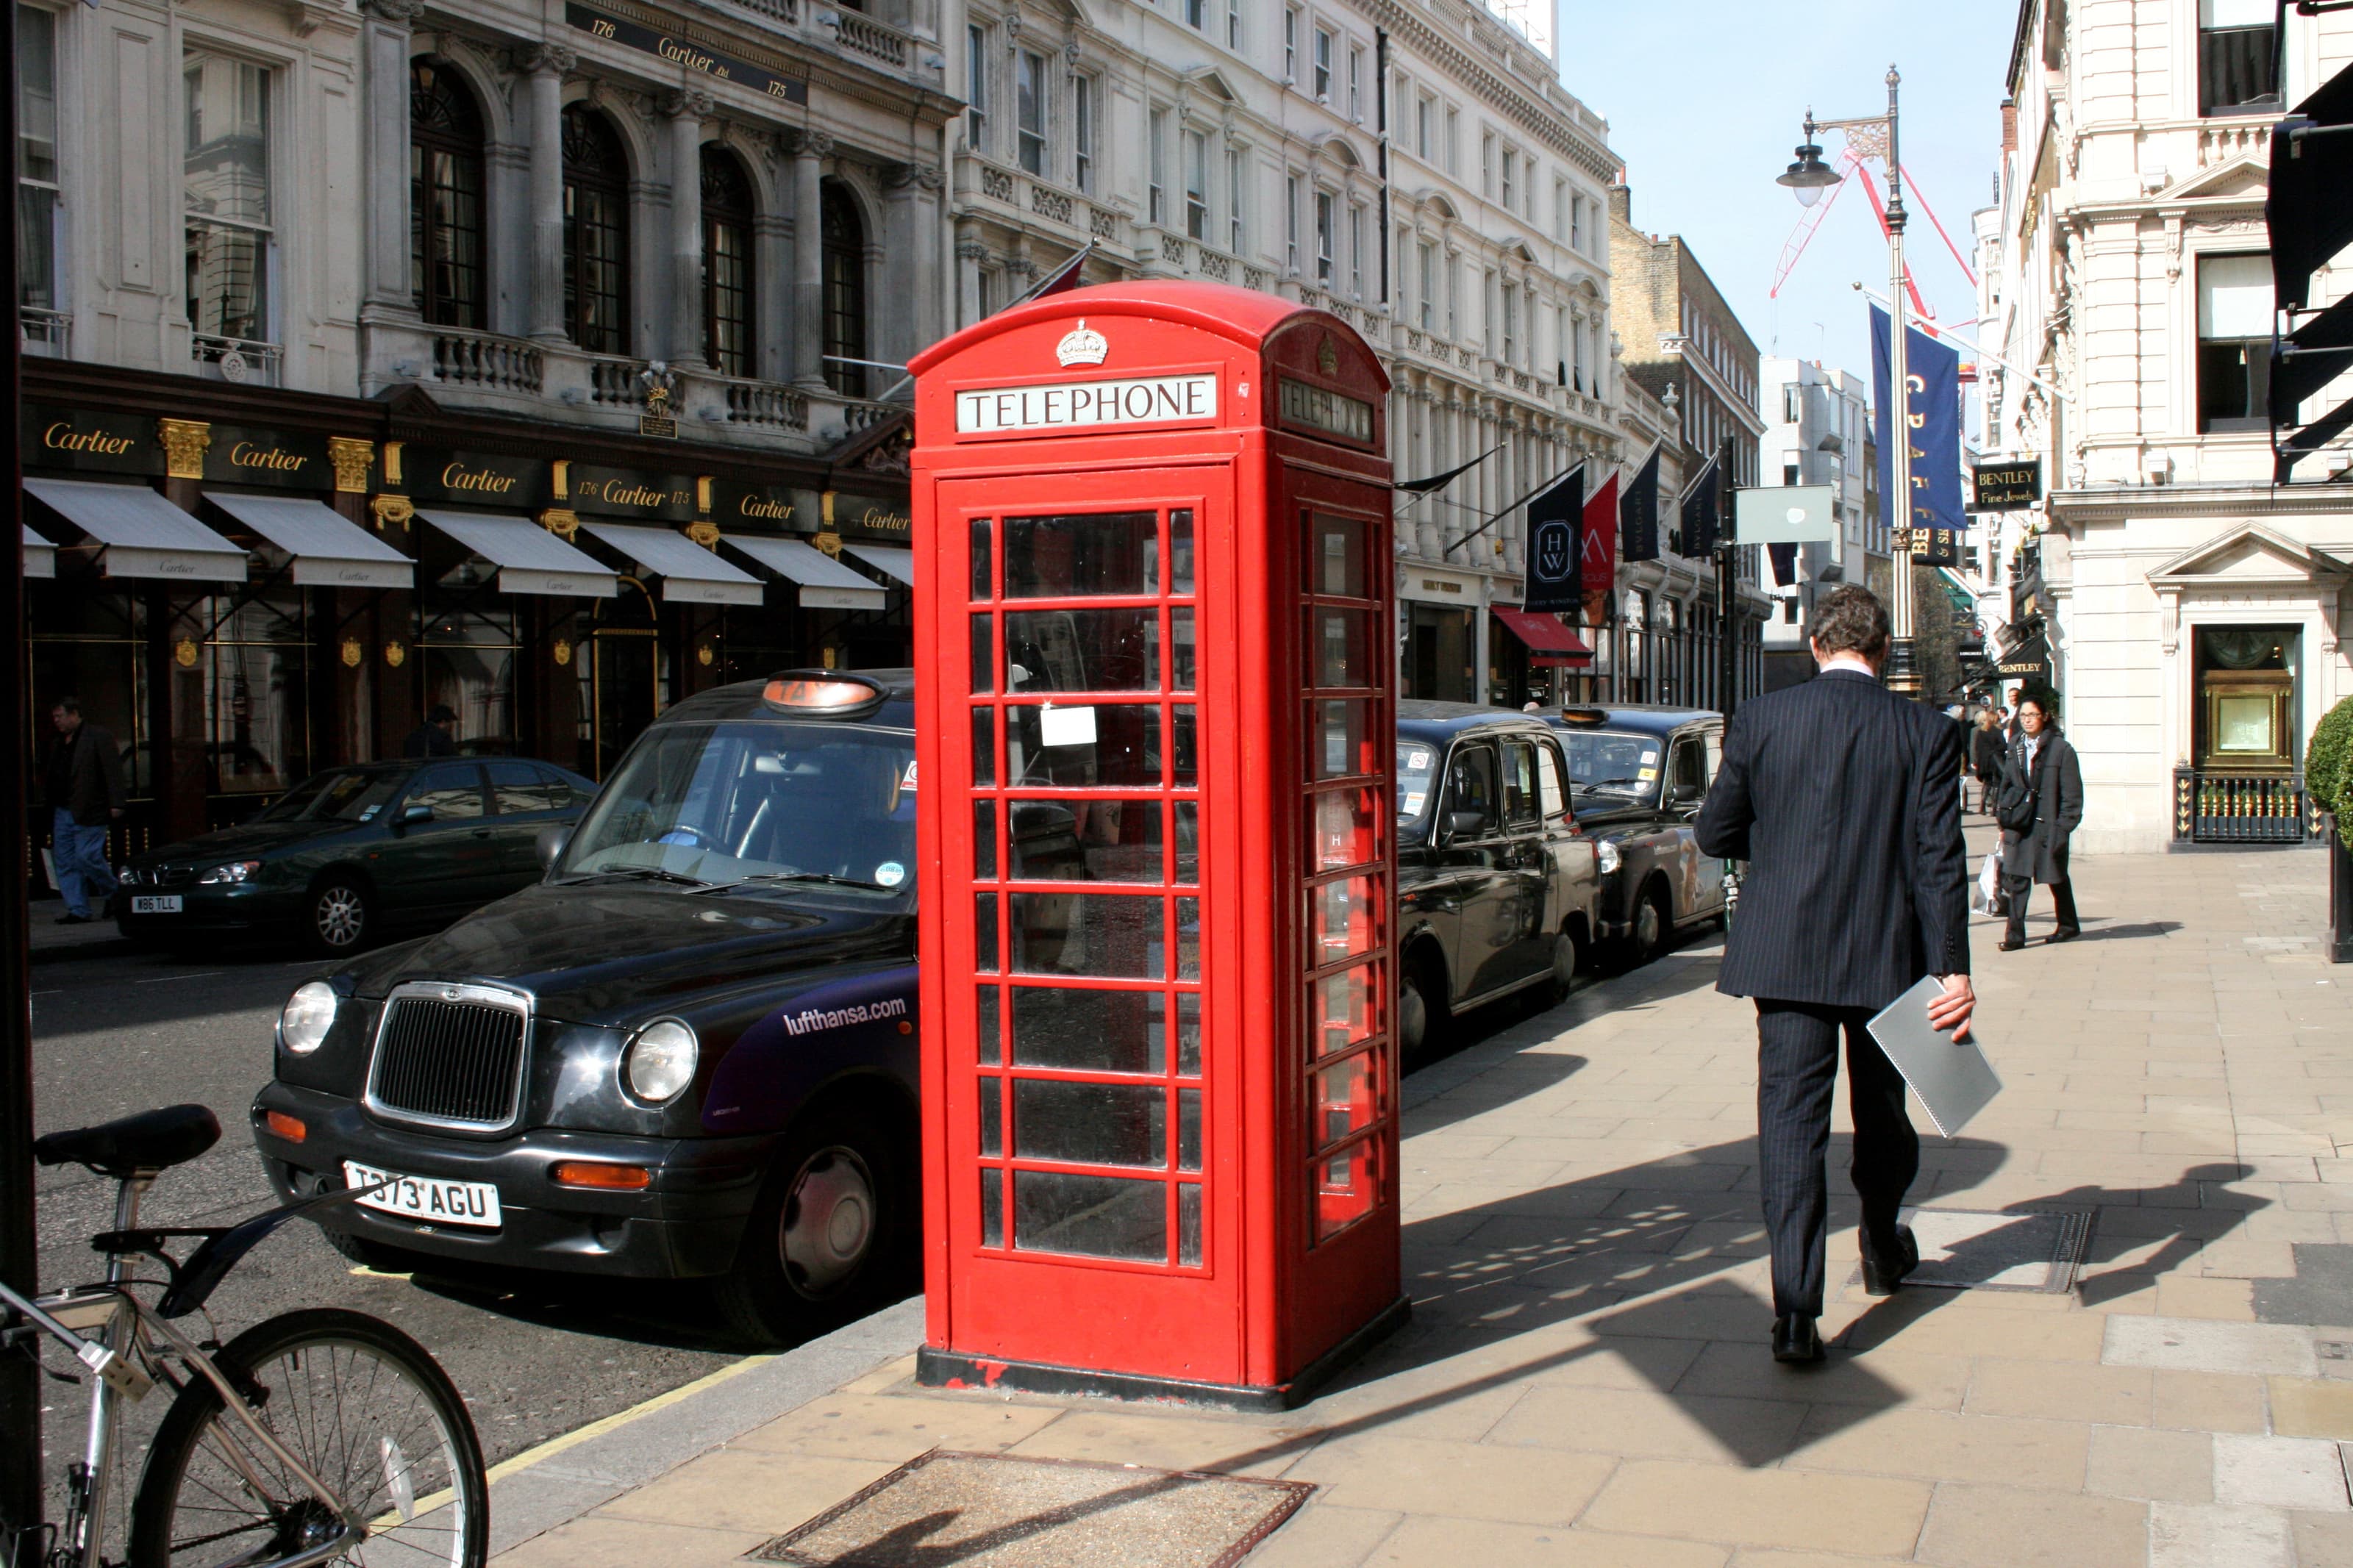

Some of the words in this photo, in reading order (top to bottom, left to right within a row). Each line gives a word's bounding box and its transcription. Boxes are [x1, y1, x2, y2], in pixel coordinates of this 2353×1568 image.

[591, 18, 616, 38] 176
[659, 37, 714, 72] Cartier
[768, 80, 788, 98] 175
[966, 380, 1207, 429] TELEPHONE
[1281, 382, 1372, 440] TELEPHONE
[45, 422, 135, 454] Cartier
[230, 441, 308, 470] Cartier
[441, 461, 516, 493] Cartier
[1979, 470, 2034, 486] BENTLEY
[578, 482, 599, 495] 176
[603, 479, 665, 507] Cartier
[671, 490, 690, 505] 175
[1982, 492, 2002, 503] Fine
[2004, 490, 2035, 501] Jewels
[740, 493, 795, 519] Cartier
[864, 507, 911, 531] Cartier
[1548, 533, 1561, 551] H
[159, 559, 196, 574] Cartier
[1544, 553, 1565, 570] W
[338, 569, 370, 581] Cartier
[2198, 594, 2296, 607] GRAFF
[1998, 663, 2041, 673] BENTLEY
[156, 897, 175, 910] TLL
[783, 998, 907, 1036] lufthansa.com
[431, 1183, 487, 1218] AGU
